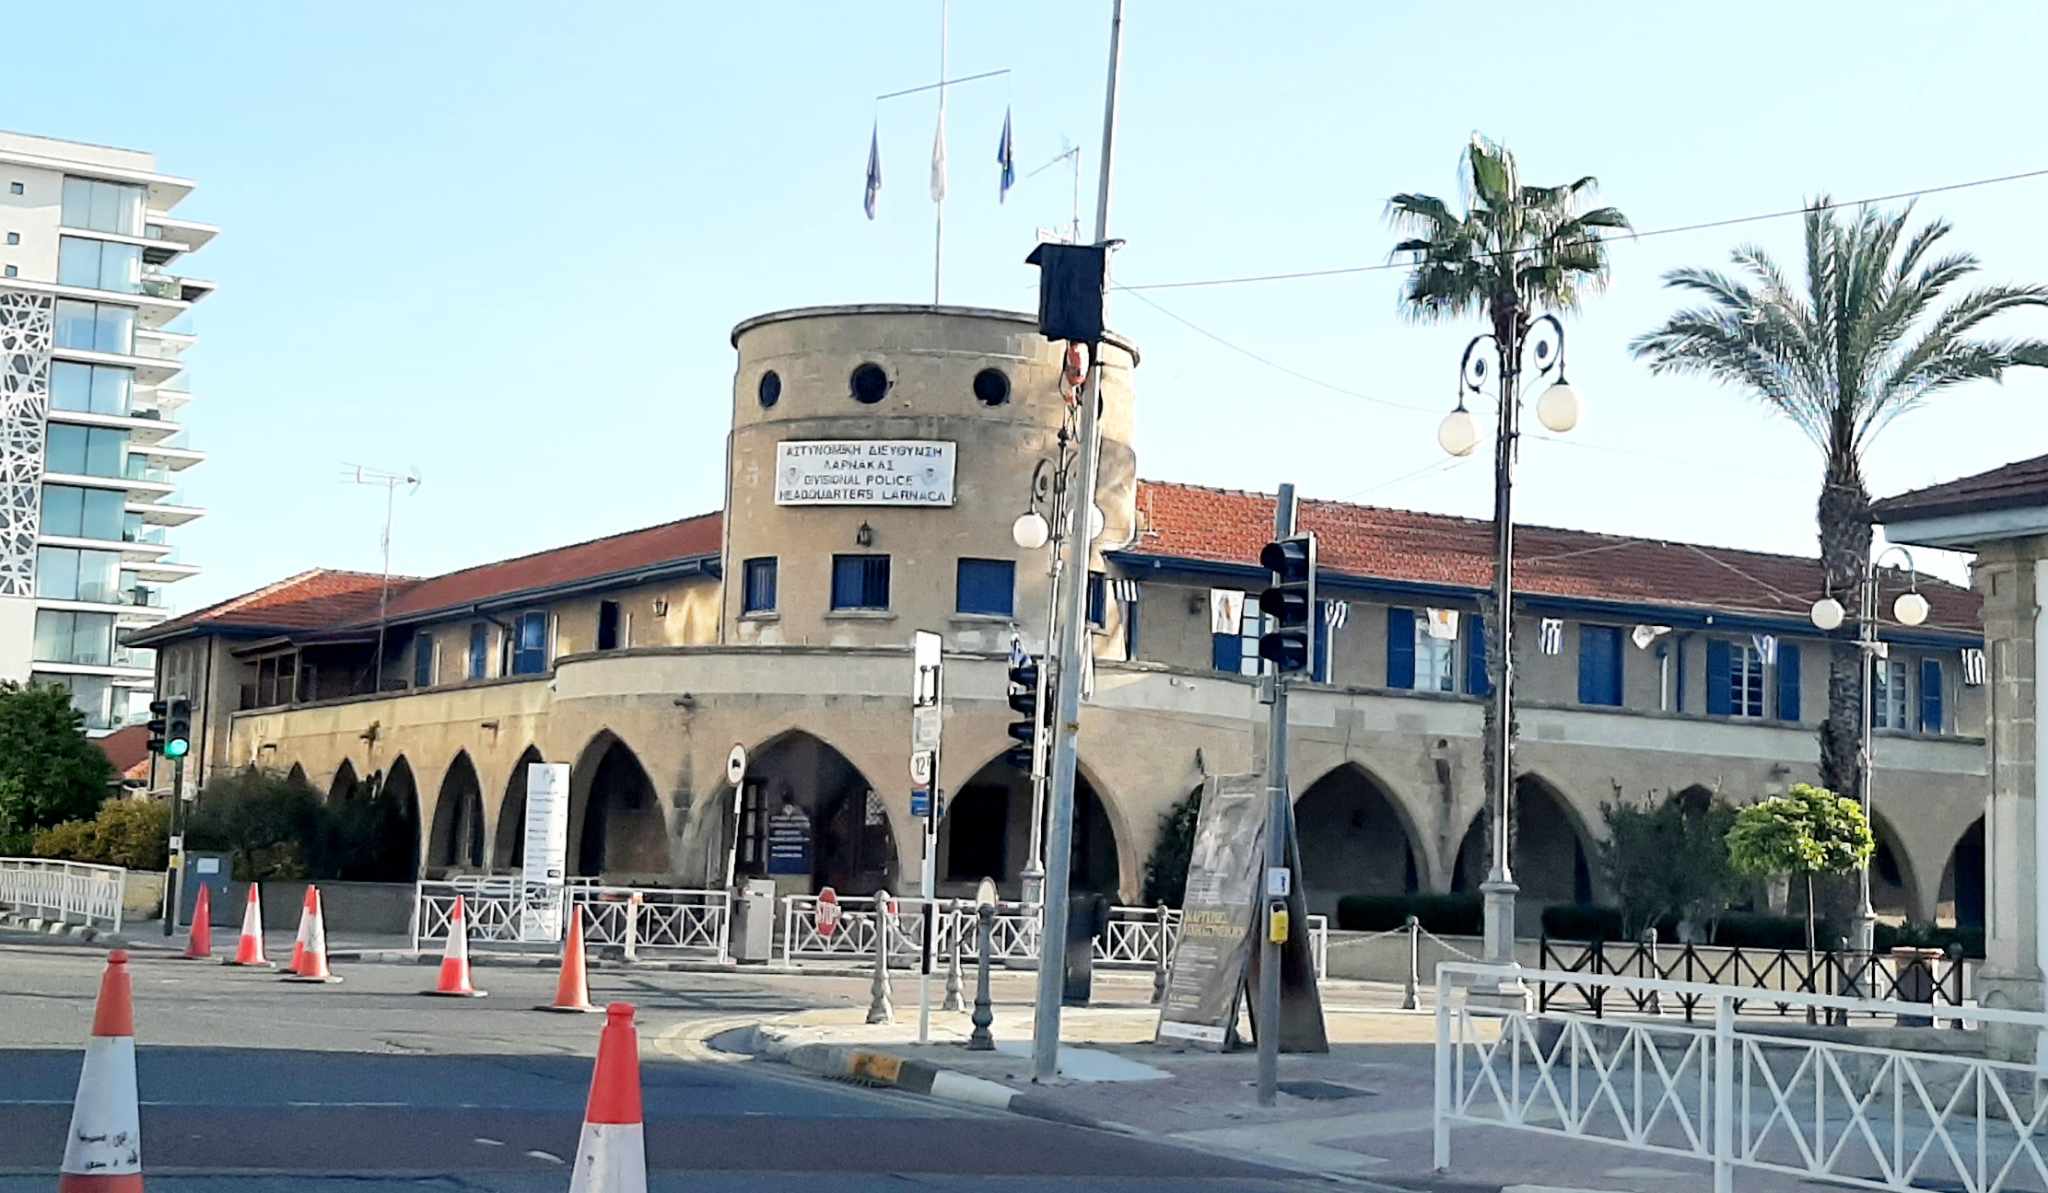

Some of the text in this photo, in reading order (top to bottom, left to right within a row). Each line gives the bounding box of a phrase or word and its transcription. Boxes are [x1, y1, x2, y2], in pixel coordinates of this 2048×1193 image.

[824, 459, 895, 471] ΛΑΡΝΑΚΑΣ
[803, 474, 913, 486] DIVISIONAL POLICE
[779, 489, 946, 502] HEADQUARTERS LARNACA
